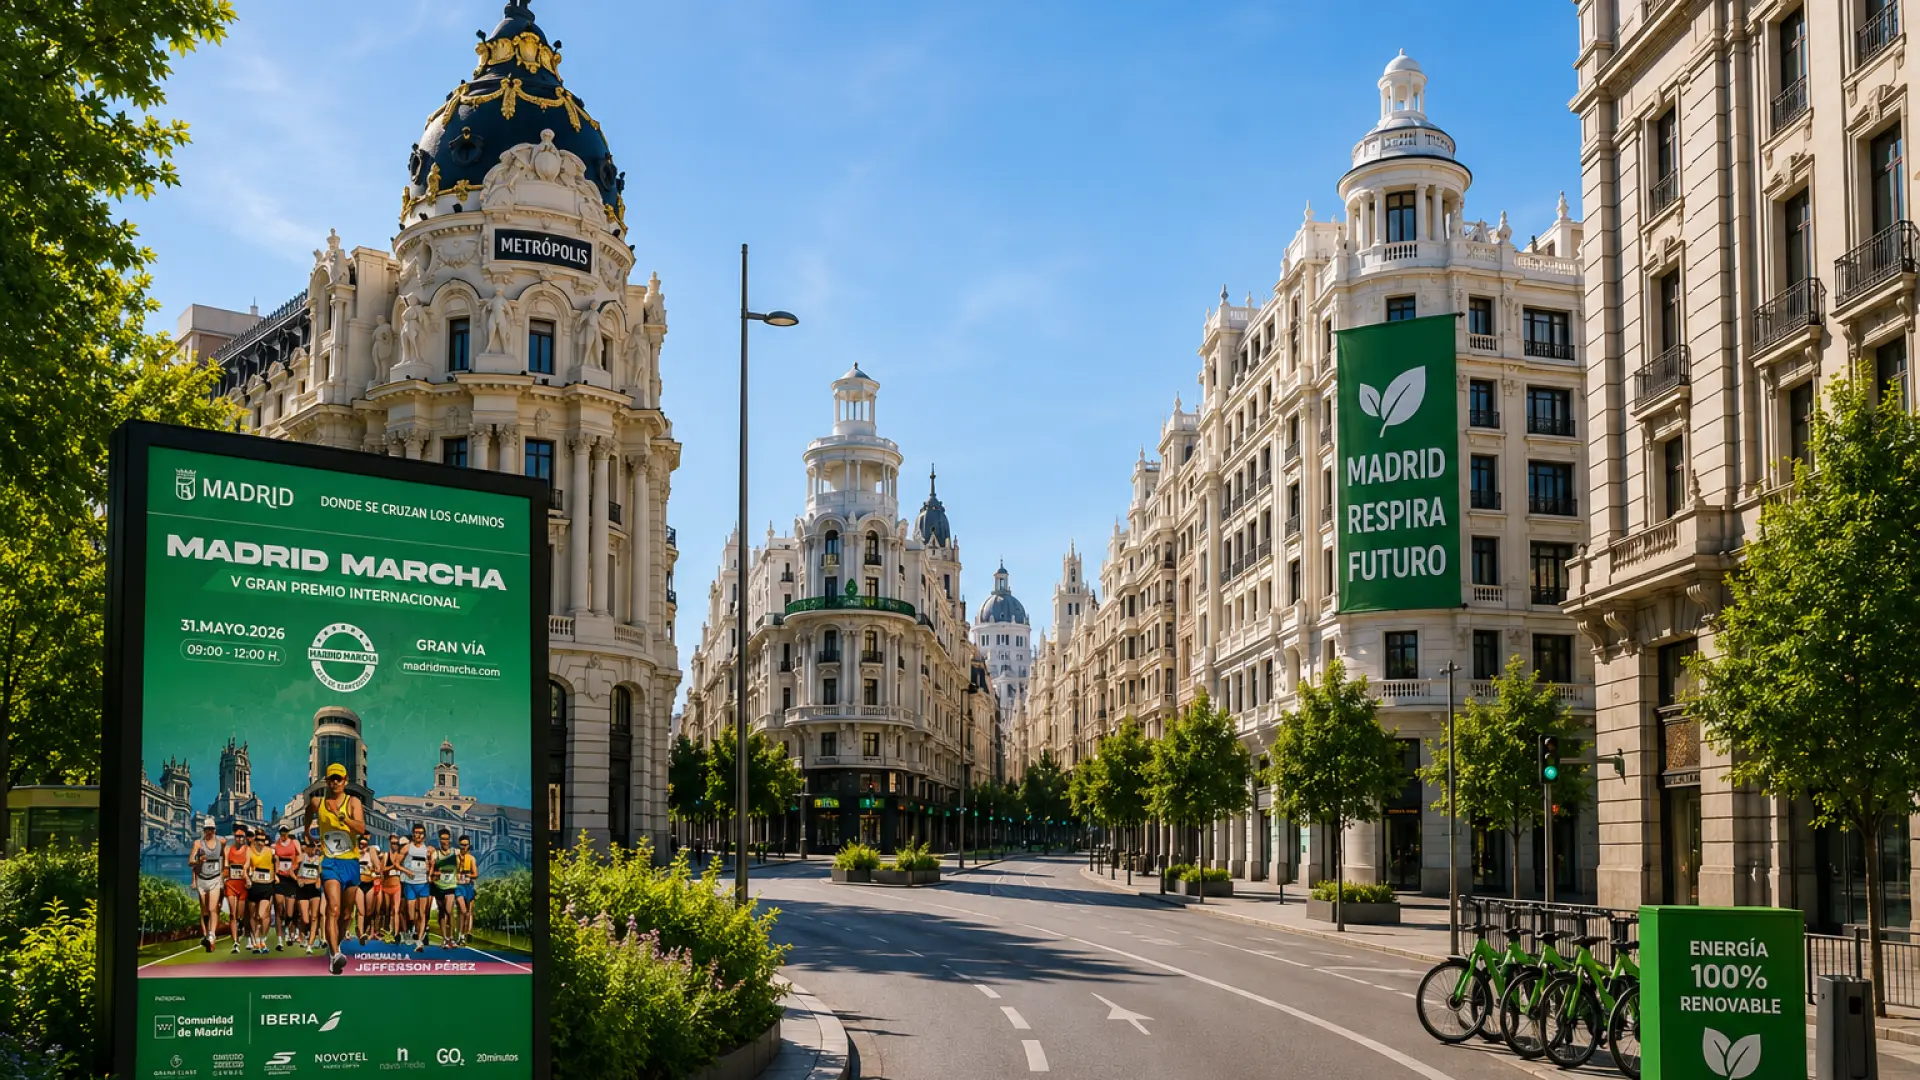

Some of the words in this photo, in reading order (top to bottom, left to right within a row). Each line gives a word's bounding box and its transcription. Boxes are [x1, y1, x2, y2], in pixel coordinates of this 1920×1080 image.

[501, 237, 588, 265] METRÓPOLIS
[1347, 448, 1446, 486] MADRID
[203, 478, 294, 509] MADRID
[320, 495, 362, 511] DONDE
[365, 501, 379, 513] SE
[381, 503, 427, 519] CRUZAN
[430, 509, 451, 522] LOS
[454, 512, 505, 528] CAMINOS
[1348, 497, 1447, 534] RESPIRA
[167, 534, 329, 572] MADRID
[341, 553, 507, 591] MARCHA
[1348, 545, 1446, 582] FUTURO
[230, 575, 242, 588] V
[245, 577, 287, 592] GRAN
[291, 581, 346, 598] PREMIO
[350, 587, 460, 609] INTERNACIONAL
[180, 618, 286, 640] 31.MAYO.2026
[187, 644, 223, 656] 09:00
[234, 648, 265, 660] 12:00
[268, 650, 280, 662] H.
[416, 639, 457, 654] GRAN
[461, 640, 486, 656] VÍA
[403, 662, 500, 677] madridmarcha.com
[1689, 937, 1769, 957] ENERGÍA
[355, 963, 431, 972] JEFFERSON
[434, 960, 476, 971] PÉREZ
[1691, 964, 1768, 990] 100%
[1680, 995, 1782, 1014] RENOVABLE
[177, 1014, 234, 1026] Comunidad
[260, 1013, 320, 1026] IBERIA
[177, 1027, 191, 1037] de
[194, 1026, 234, 1037] Madrid
[314, 1052, 368, 1063] NOVOTEL
[476, 1053, 519, 1064] 20minutos
